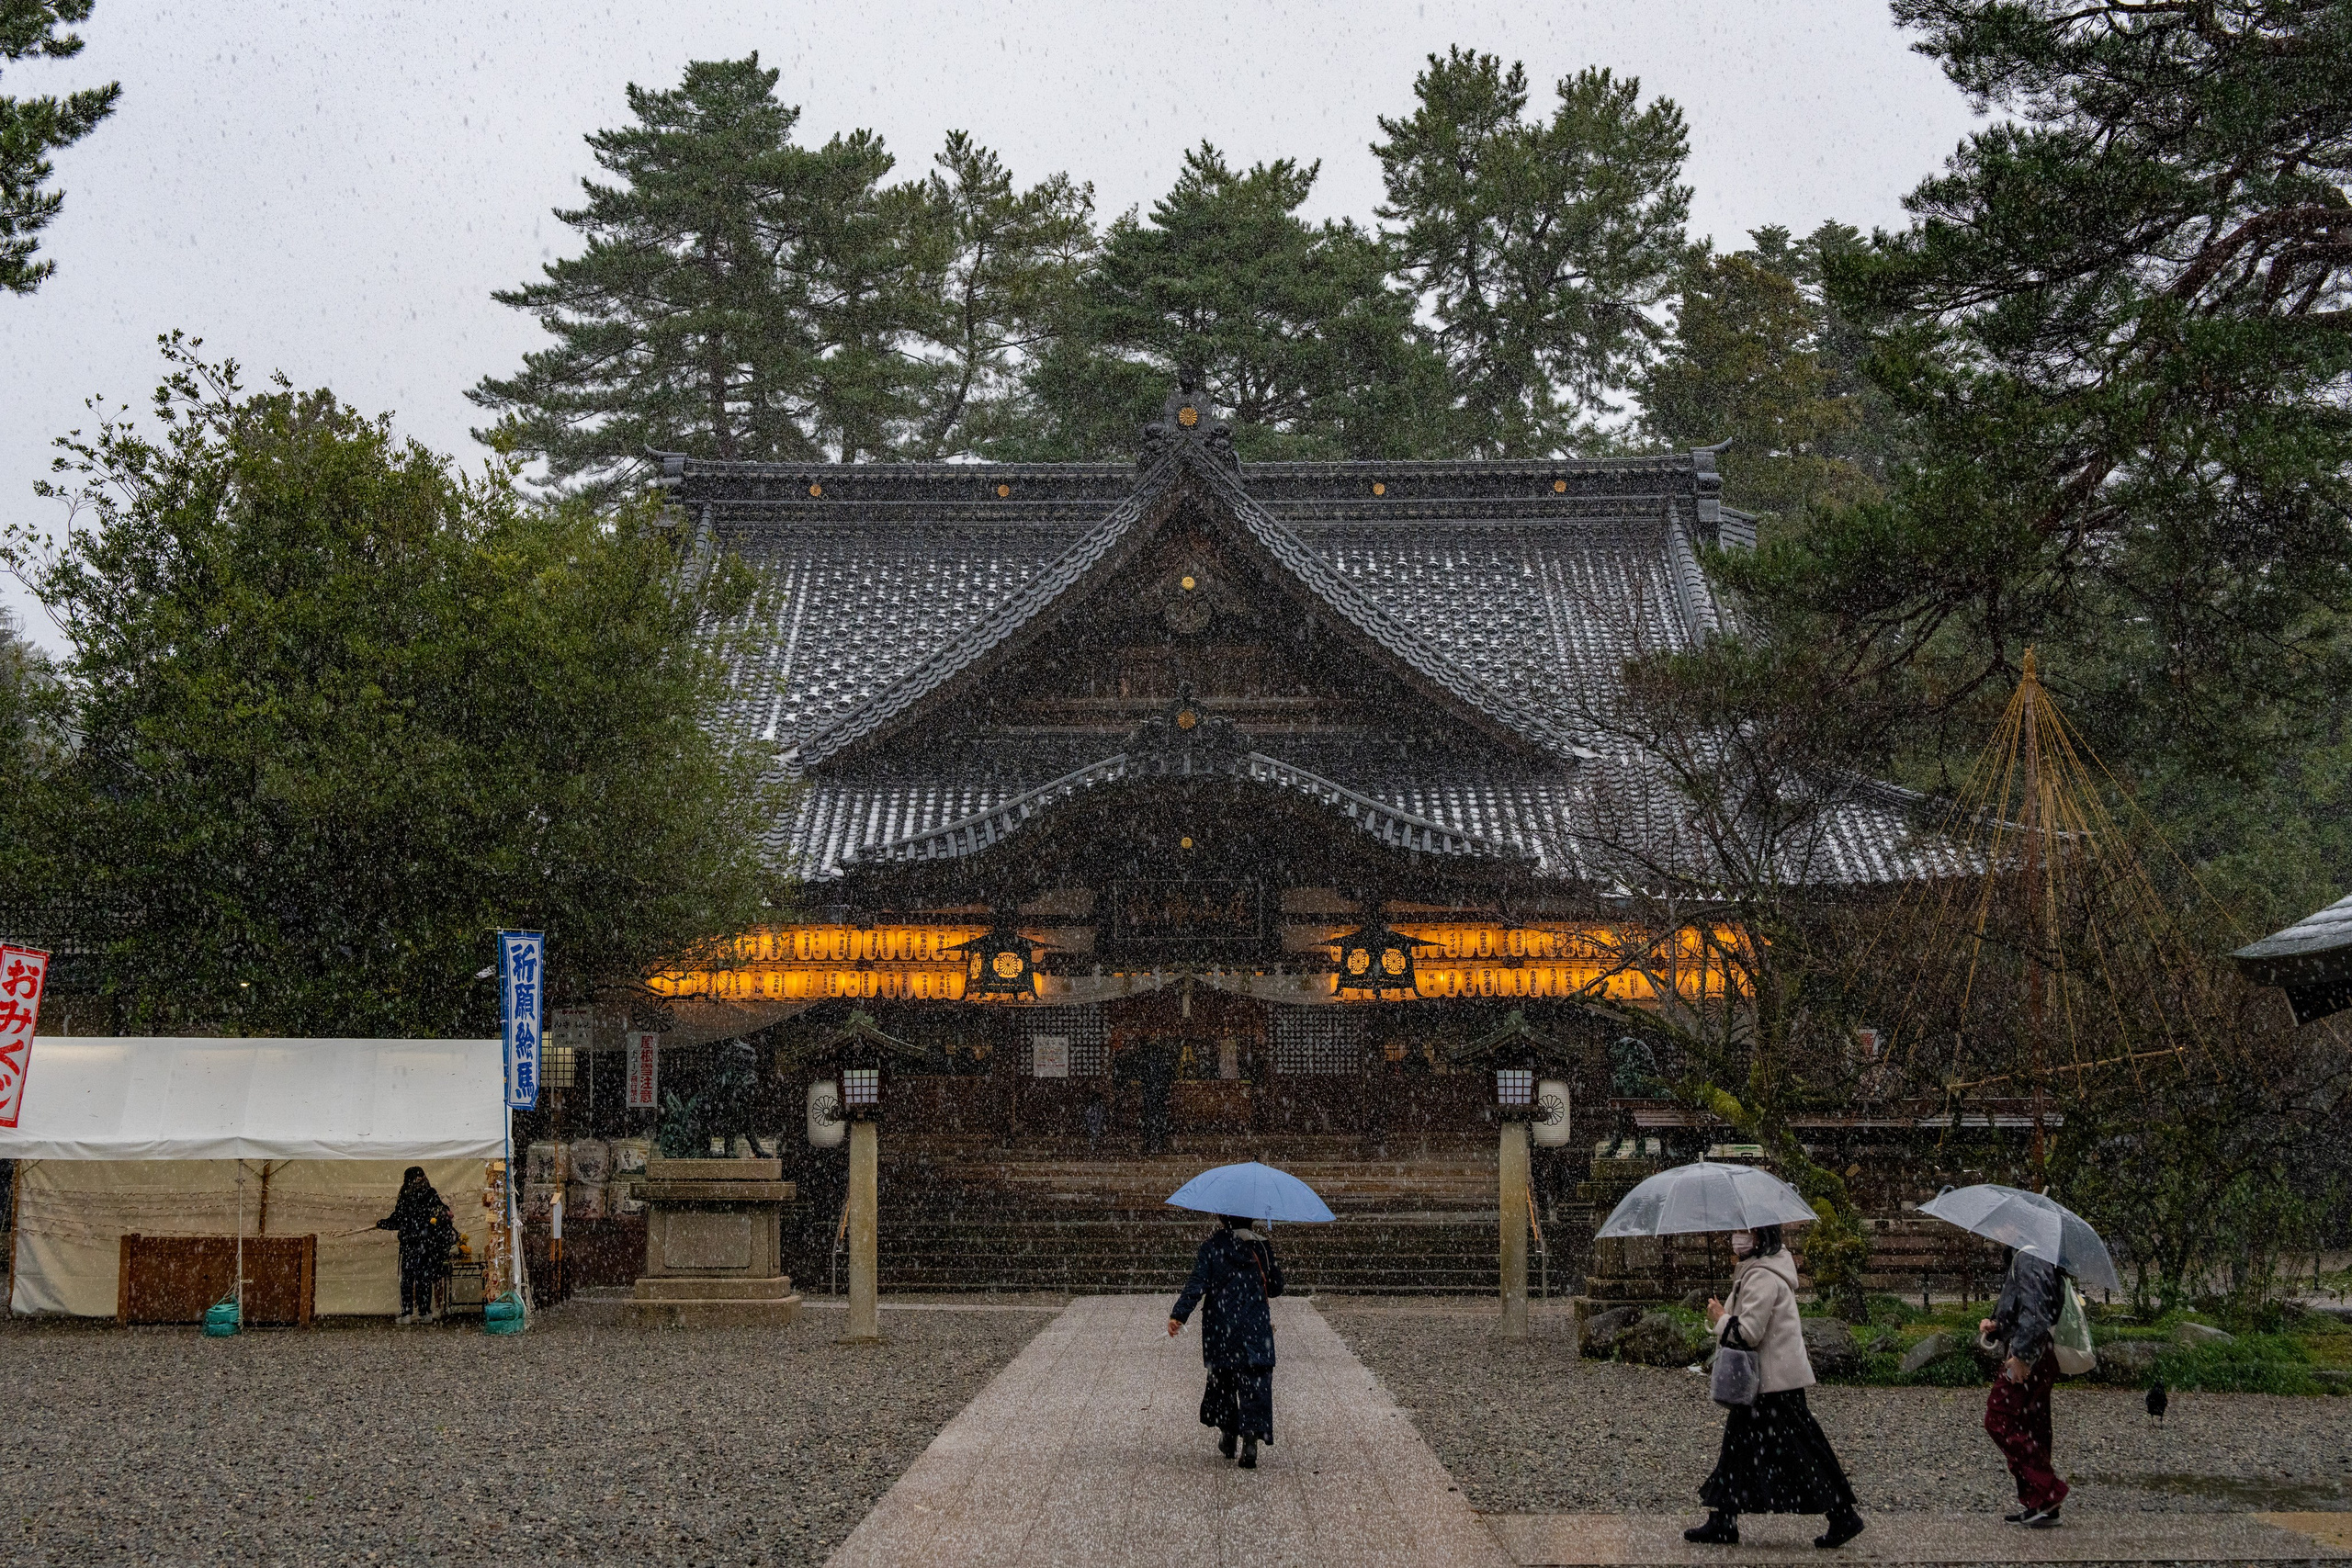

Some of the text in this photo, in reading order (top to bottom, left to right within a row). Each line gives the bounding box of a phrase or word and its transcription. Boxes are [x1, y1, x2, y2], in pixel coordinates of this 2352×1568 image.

[510, 943, 537, 1100] 祈願絵馬
[640, 1035, 654, 1103] 屋根雪注意
